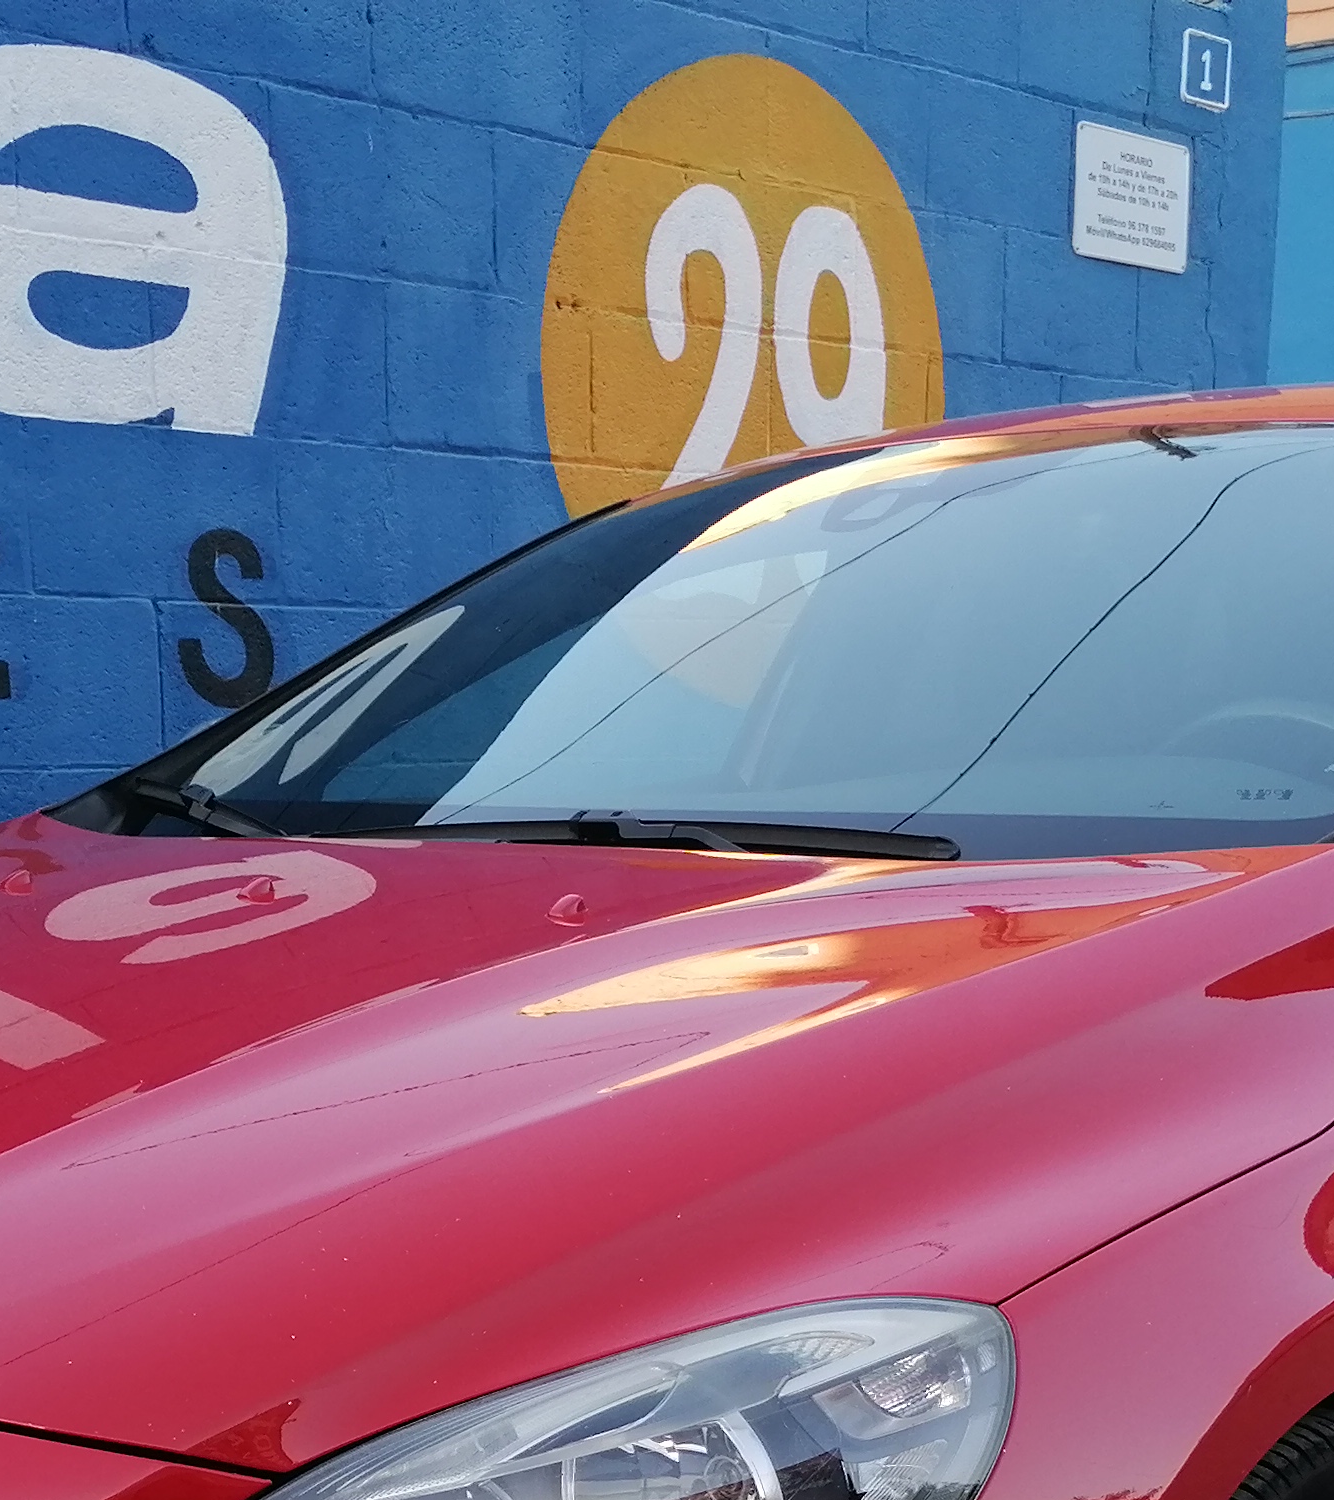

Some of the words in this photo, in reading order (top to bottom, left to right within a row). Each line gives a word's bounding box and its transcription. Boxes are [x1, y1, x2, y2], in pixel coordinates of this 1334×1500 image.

[1201, 49, 1212, 91] 1
[1120, 151, 1153, 168] HORARIO
[1088, 172, 1097, 182] de
[1137, 184, 1146, 193] de
[1102, 161, 1112, 172] De
[1113, 163, 1133, 177] Lunes
[1140, 170, 1165, 185] Viernes
[1128, 195, 1137, 204] de
